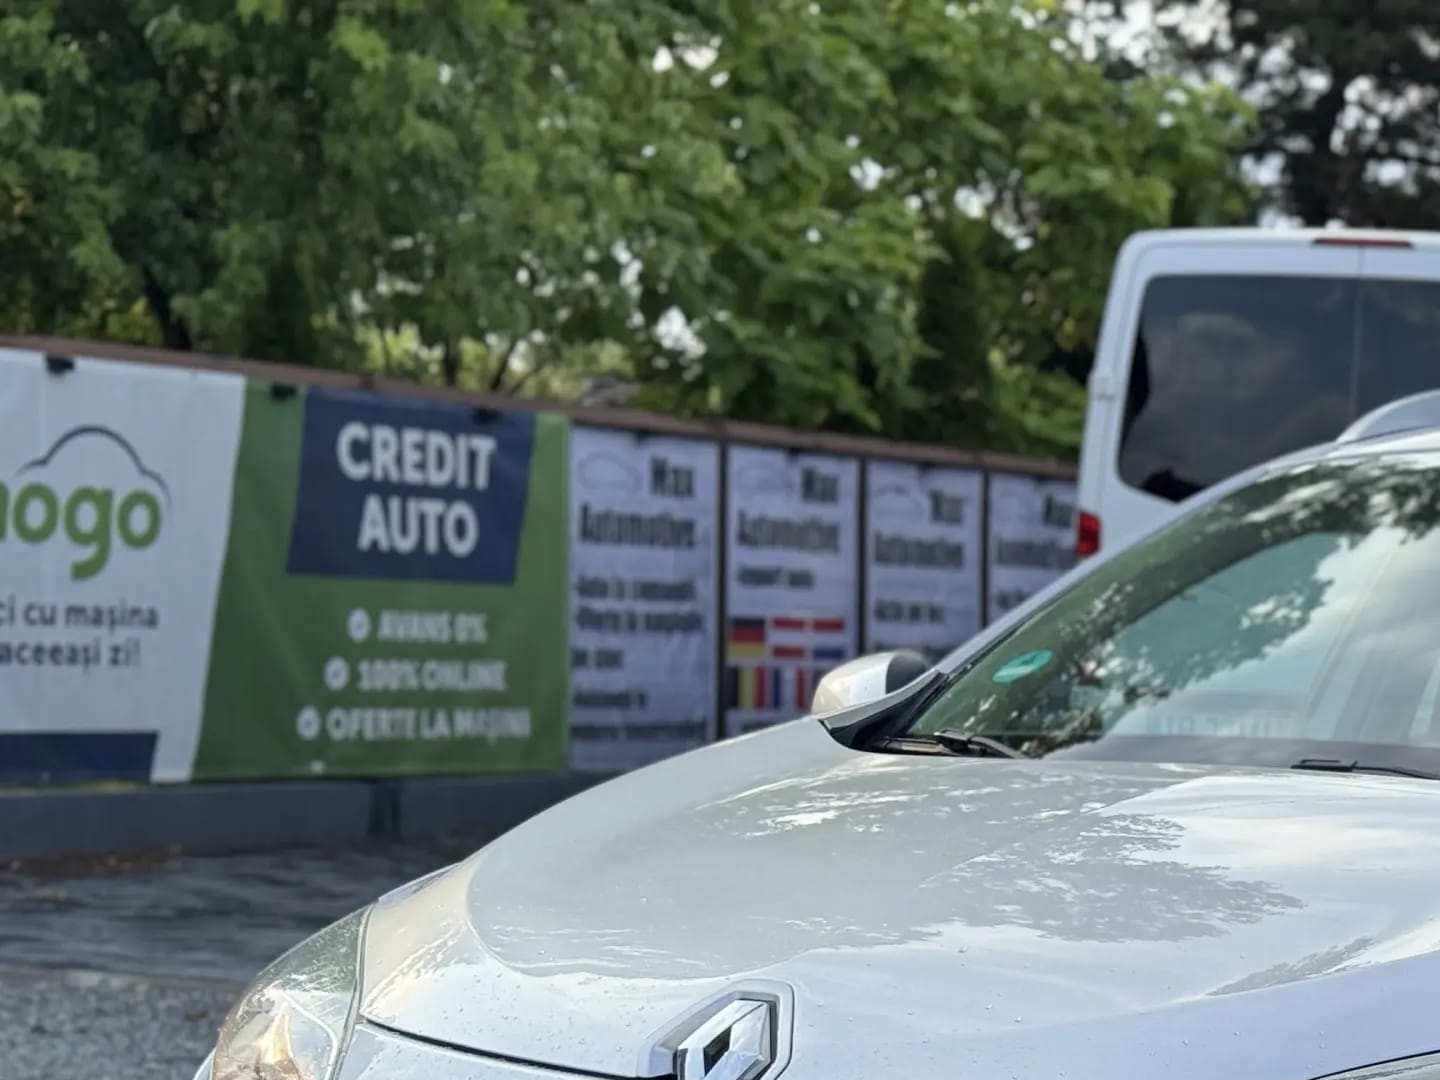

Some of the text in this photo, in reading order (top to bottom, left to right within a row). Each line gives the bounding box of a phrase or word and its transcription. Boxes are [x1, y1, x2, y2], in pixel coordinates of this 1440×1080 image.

[335, 420, 497, 491] CREDIT
[357, 492, 479, 558] AUTO
[23, 602, 57, 627] cu
[376, 608, 451, 643] AVANS
[357, 658, 507, 693] 100% ONLINE
[325, 706, 416, 741] OFERTE
[419, 707, 450, 740] LA
